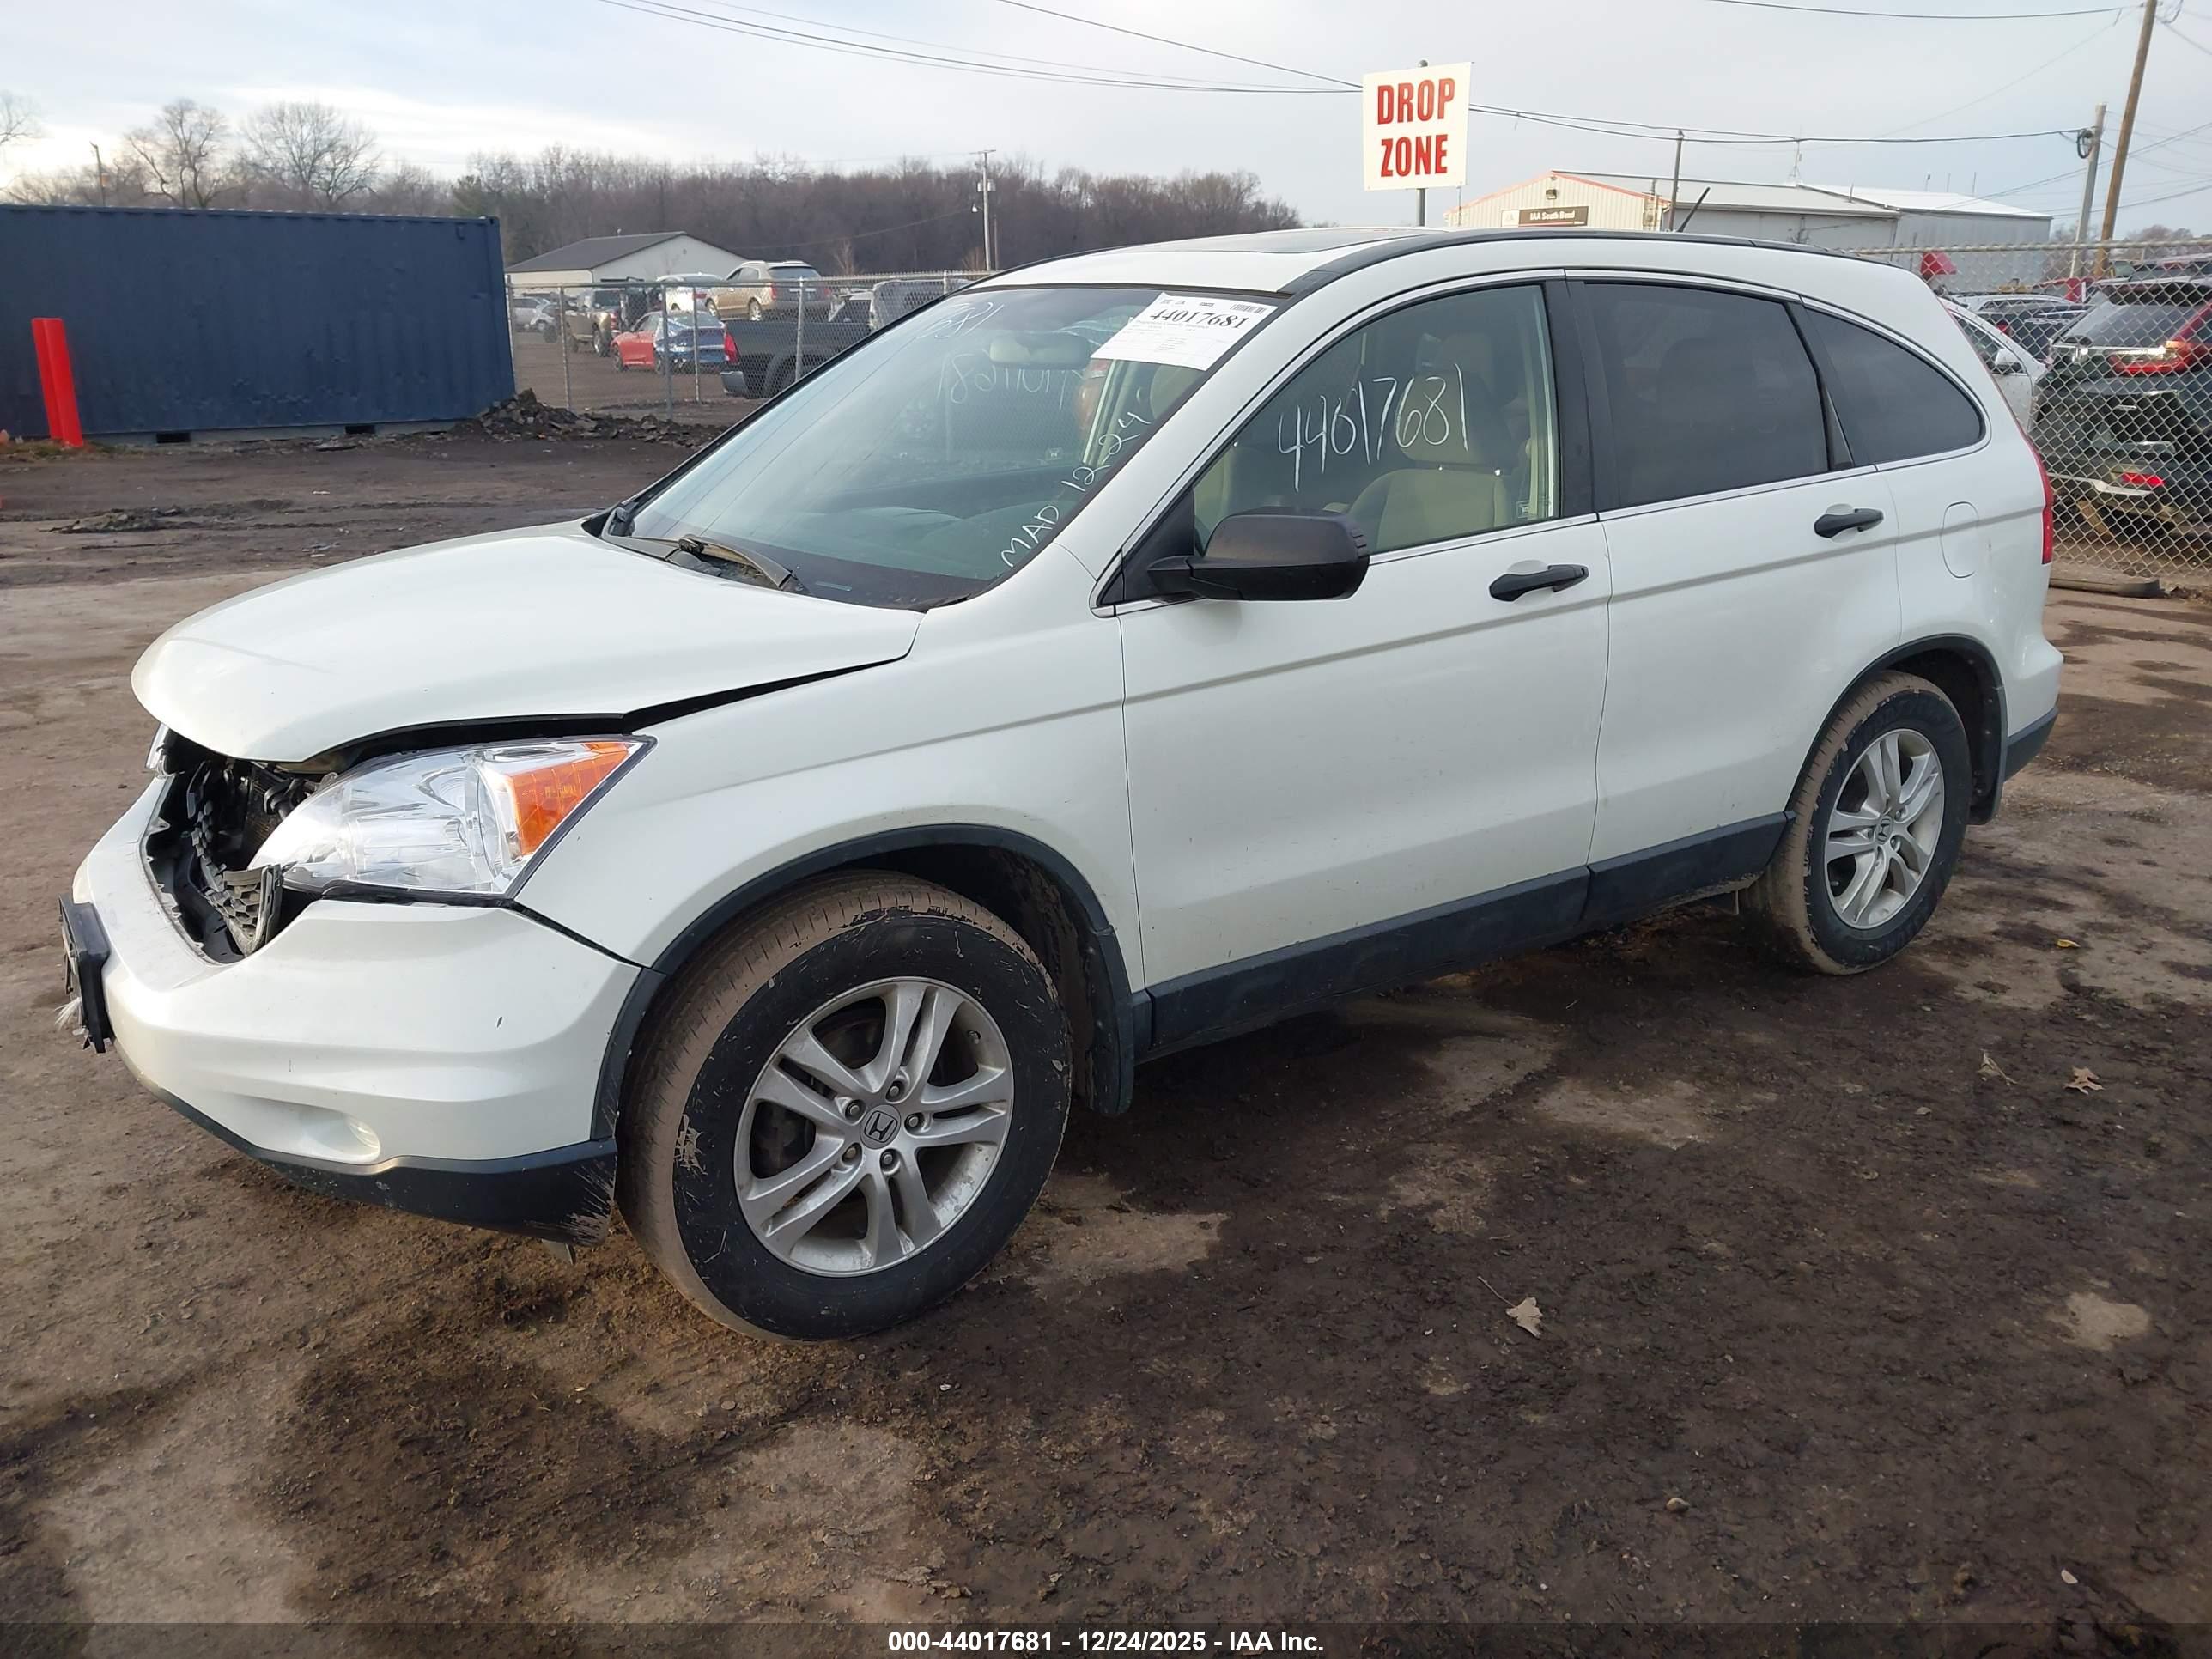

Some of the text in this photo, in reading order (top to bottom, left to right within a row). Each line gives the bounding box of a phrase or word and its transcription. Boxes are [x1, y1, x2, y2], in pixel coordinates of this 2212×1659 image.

[1377, 78, 1455, 125] DROP
[1381, 134, 1448, 177] ZONE
[1150, 309, 1249, 329] 44017681
[1000, 505, 1060, 568] MAD
